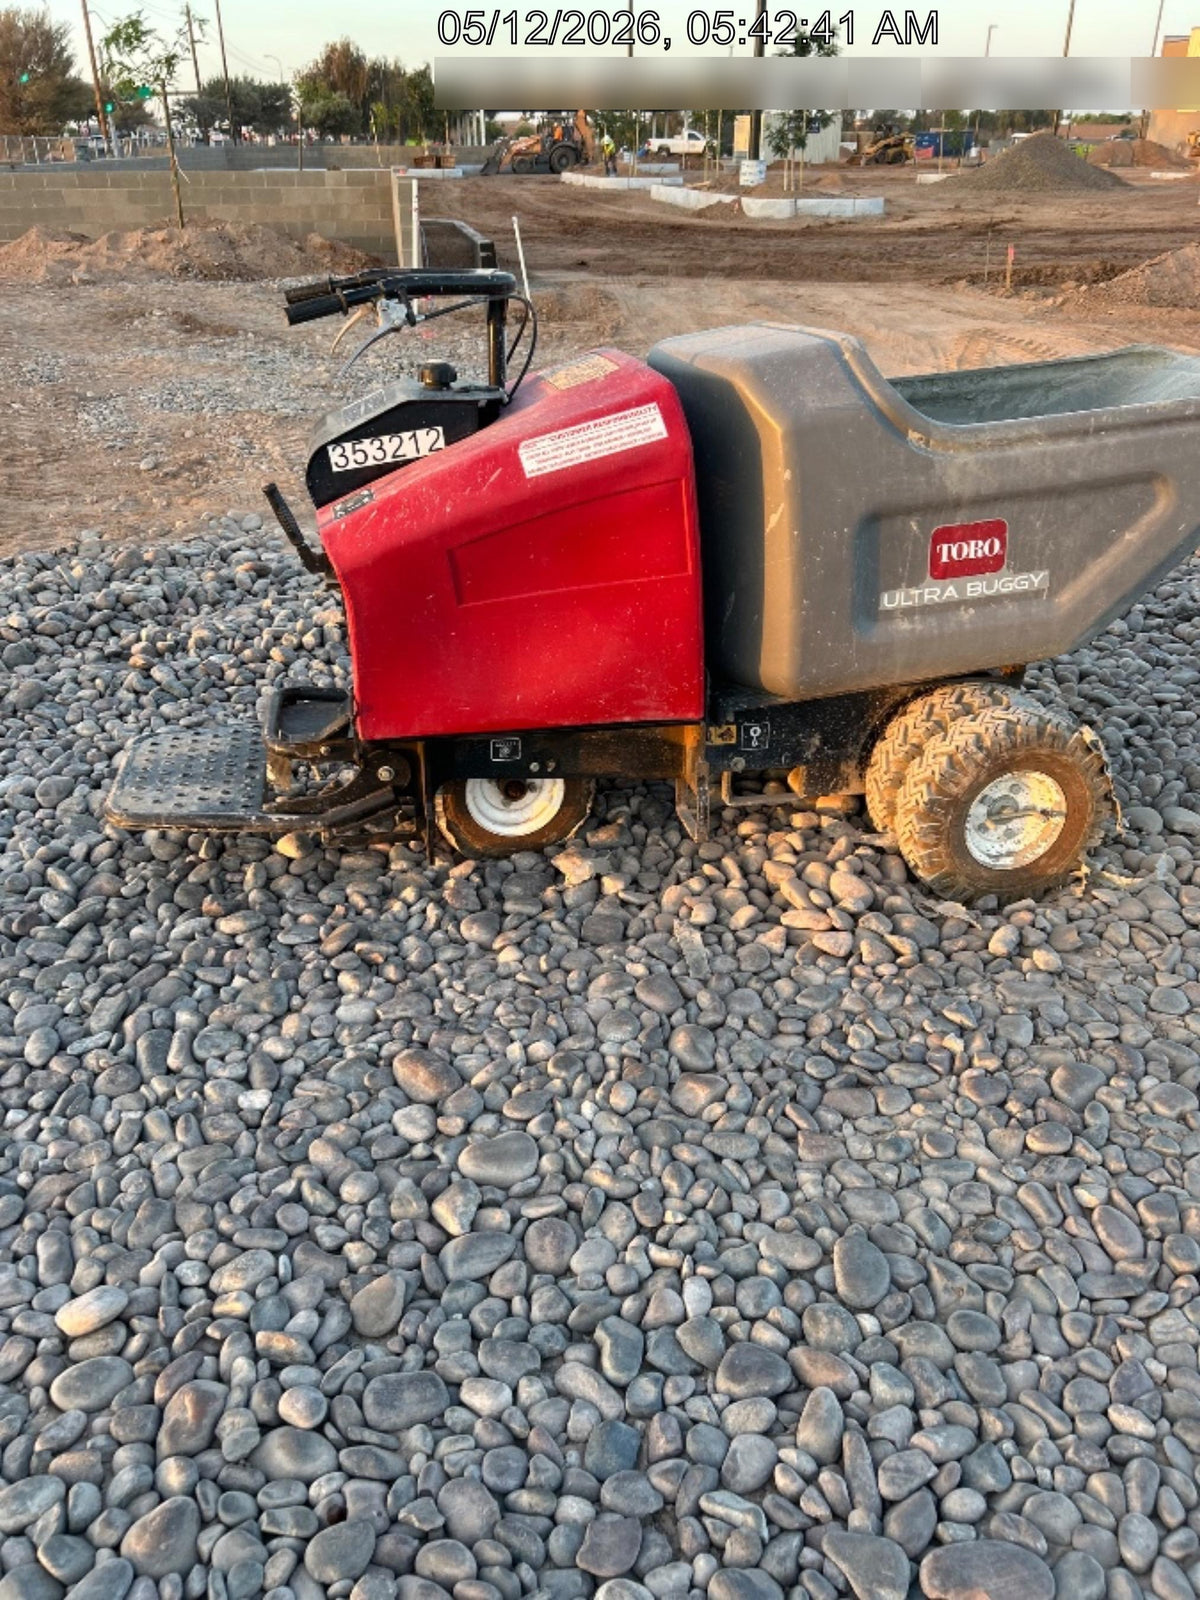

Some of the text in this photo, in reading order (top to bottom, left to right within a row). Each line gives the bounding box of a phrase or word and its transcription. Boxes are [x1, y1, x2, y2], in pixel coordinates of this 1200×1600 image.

[331, 427, 443, 469] 353212
[936, 537, 1001, 563] TORO
[883, 573, 1044, 607] ULTRA BUGGY
